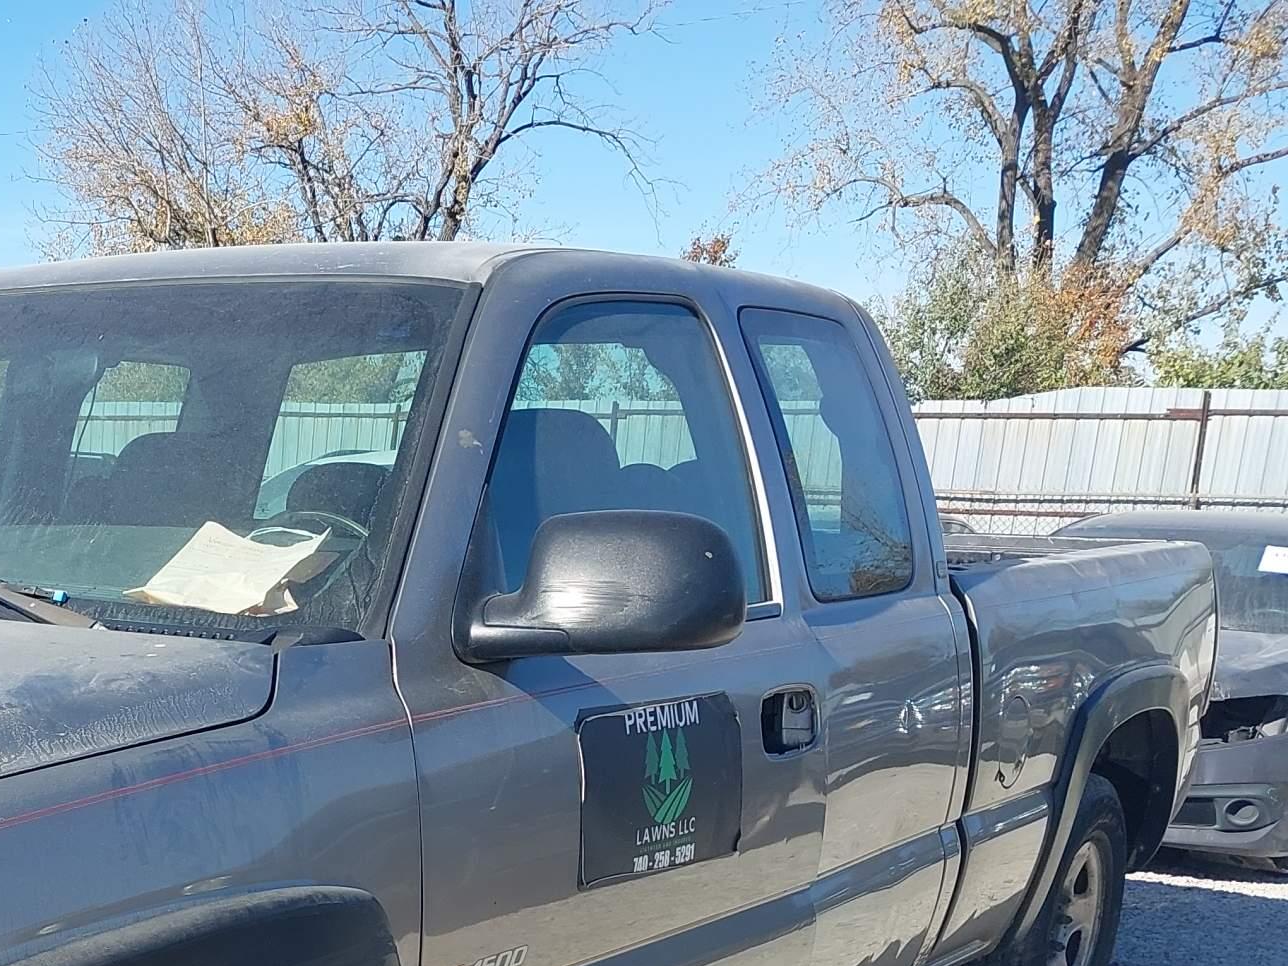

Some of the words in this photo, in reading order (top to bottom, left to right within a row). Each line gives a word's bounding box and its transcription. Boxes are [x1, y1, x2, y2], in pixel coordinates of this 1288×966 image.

[624, 700, 700, 735] PREMIUM
[636, 821, 676, 845] LAWNS
[678, 816, 696, 835] LLC
